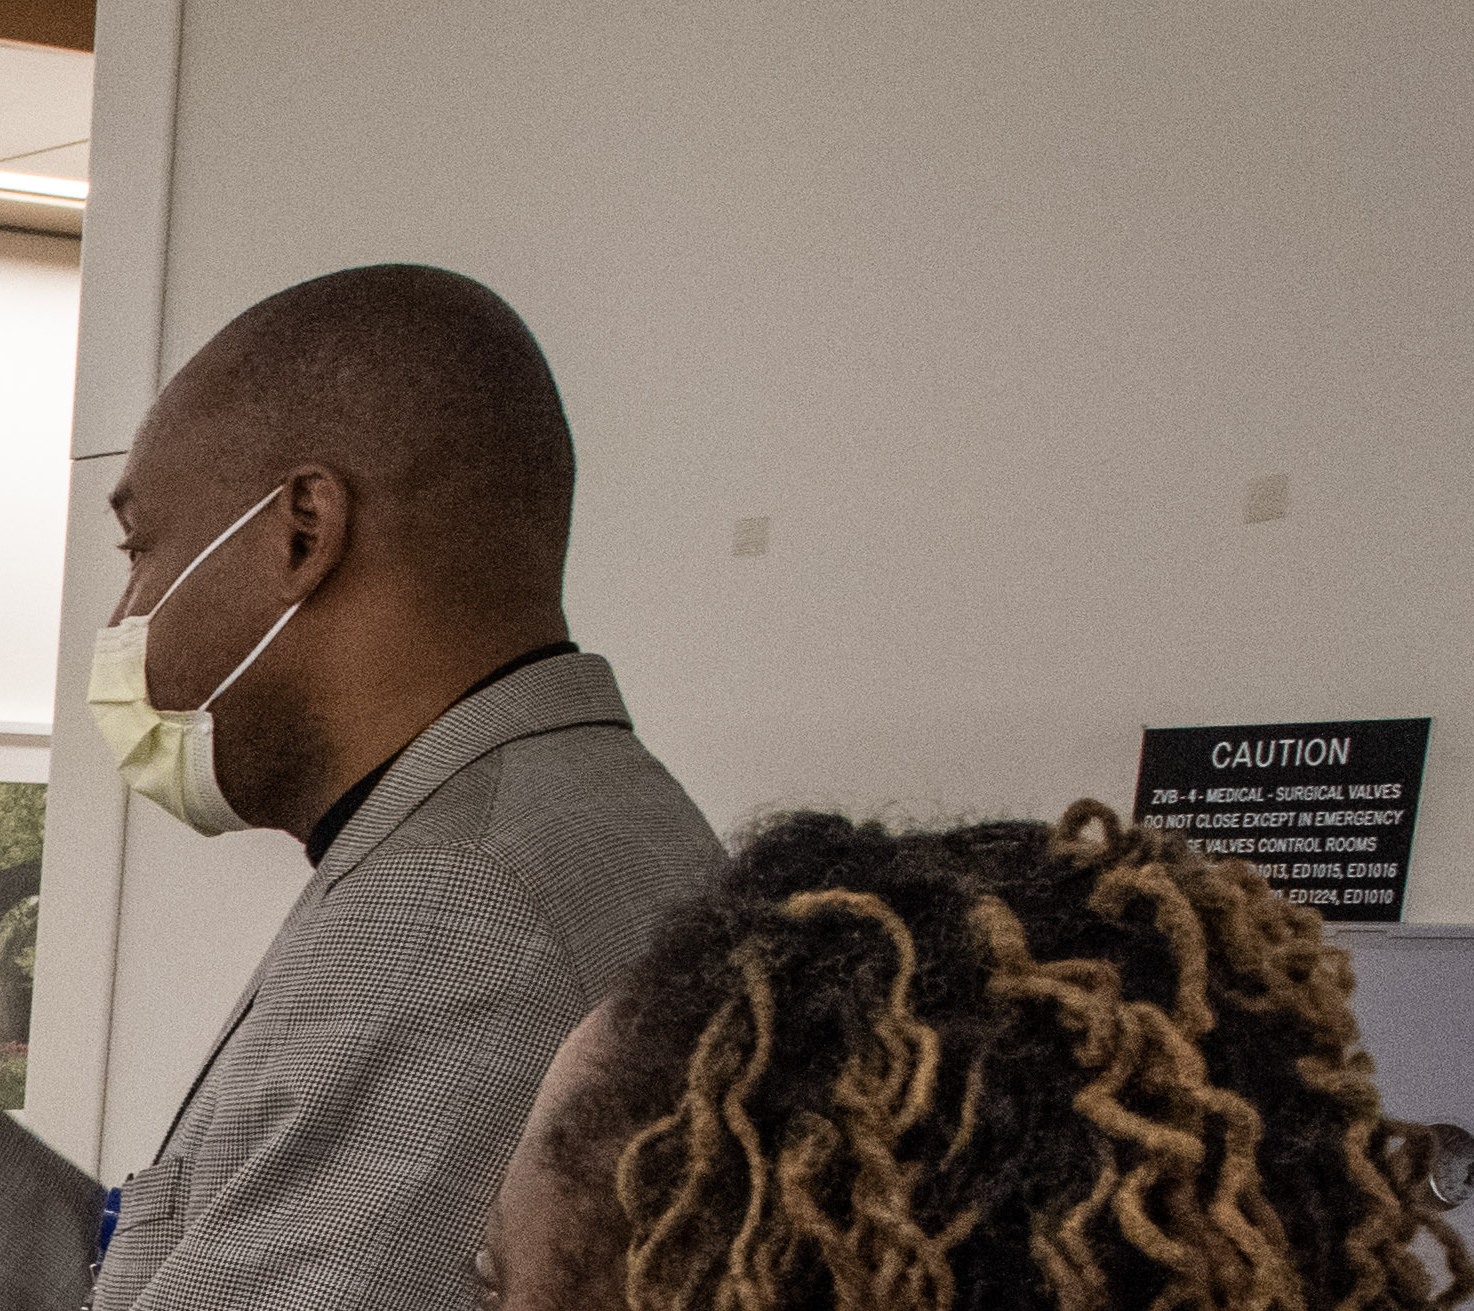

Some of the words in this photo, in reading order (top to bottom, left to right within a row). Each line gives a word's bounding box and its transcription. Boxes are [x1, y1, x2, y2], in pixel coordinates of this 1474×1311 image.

[1212, 736, 1350, 769] CAUTION
[1151, 789, 1179, 804] ZVB
[1206, 787, 1264, 802] MEDICAL
[1276, 785, 1344, 801] SURGICAL
[1348, 783, 1402, 799] VALVES
[1166, 813, 1194, 829] NOT
[1196, 813, 1241, 828] CLOSE
[1243, 811, 1296, 828] EXCEPT
[1298, 812, 1313, 827] IN
[1315, 810, 1404, 826] EMERGENCY
[1206, 838, 1256, 854] VALVES
[1258, 837, 1322, 853] CONTROL
[1325, 836, 1378, 852] ROOMS
[1292, 863, 1343, 879] ED1015,
[1288, 889, 1339, 905] ED1224,
[1344, 888, 1394, 904] ED1010
